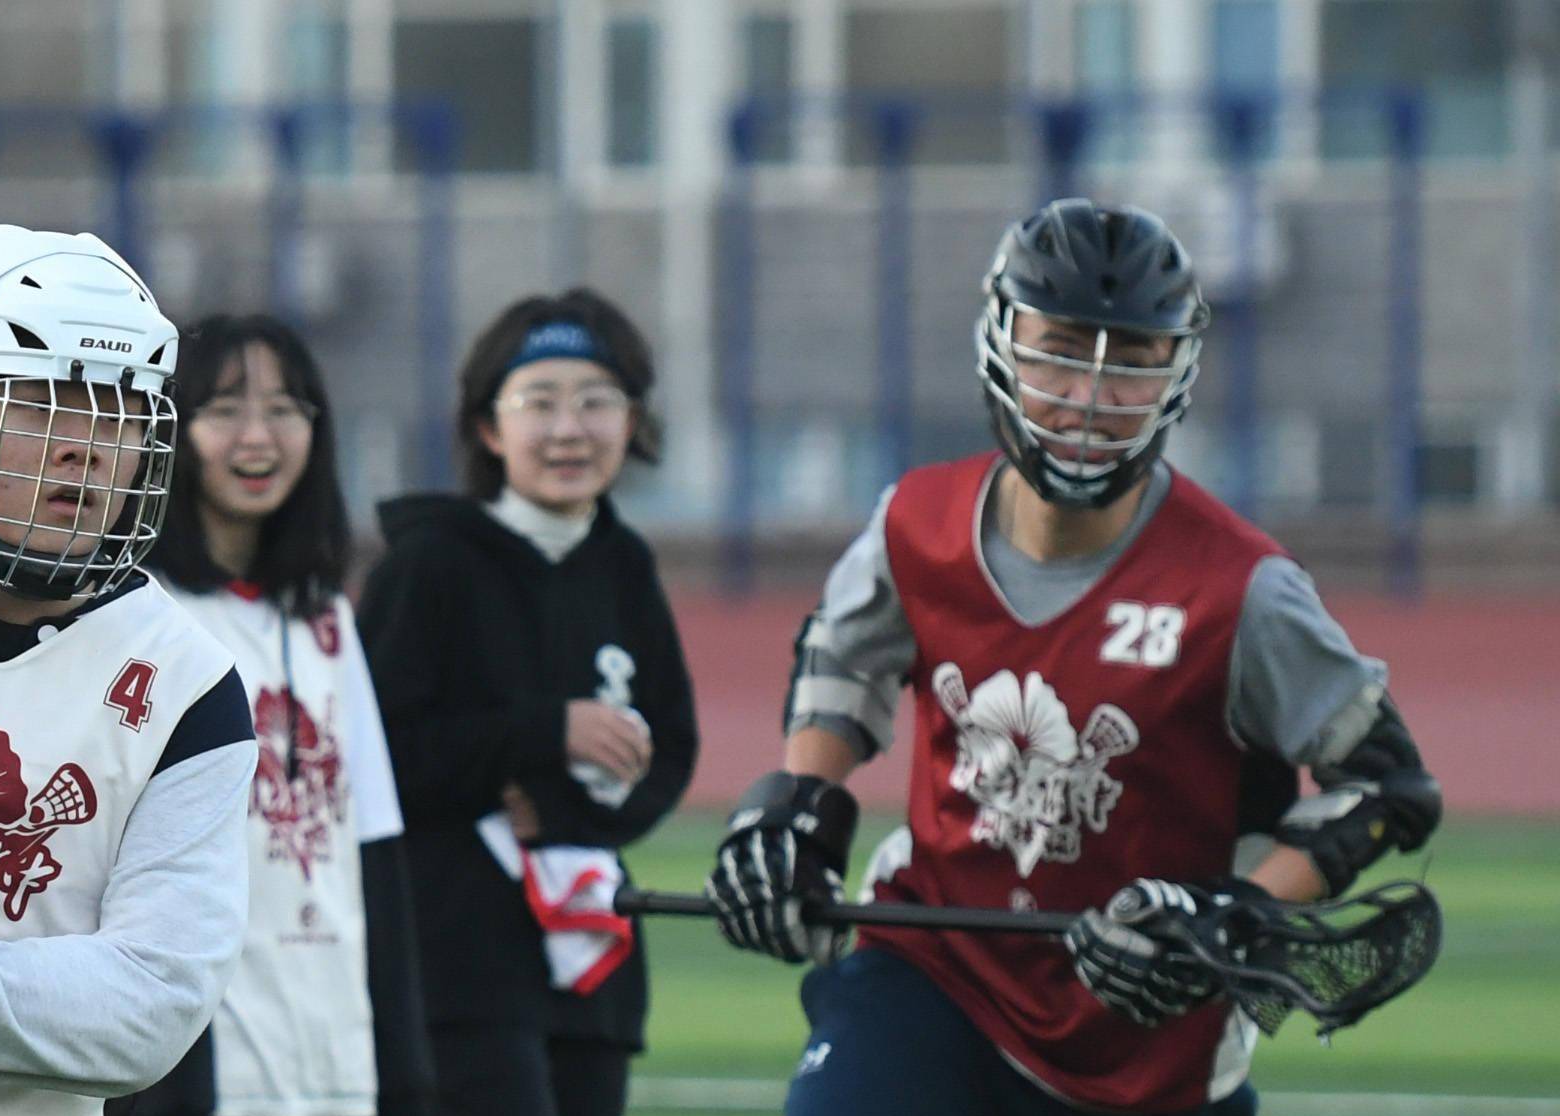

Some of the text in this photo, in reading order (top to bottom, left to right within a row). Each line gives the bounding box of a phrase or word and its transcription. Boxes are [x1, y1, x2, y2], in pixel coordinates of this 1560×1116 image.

[79, 337, 133, 354] BAUD
[1099, 599, 1186, 668] 28
[103, 657, 158, 733] 4
